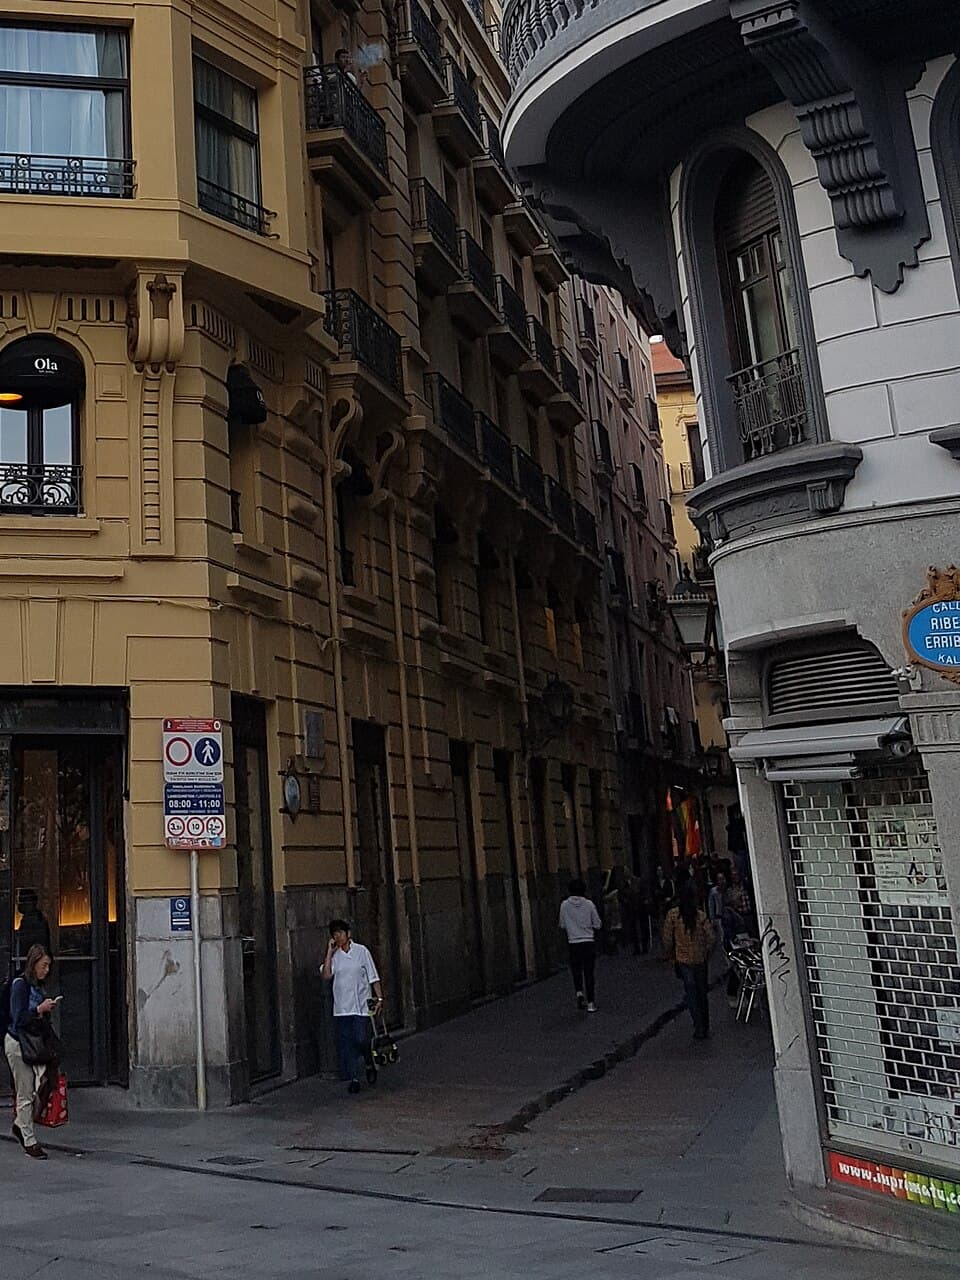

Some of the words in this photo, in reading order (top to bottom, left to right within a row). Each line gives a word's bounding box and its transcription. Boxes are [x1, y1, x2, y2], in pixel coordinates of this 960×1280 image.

[33, 358, 58, 371] Ola
[931, 617, 960, 630] RIBE
[926, 636, 960, 649] ERRIB
[169, 800, 191, 808] 08:00
[199, 800, 221, 808] 11:00
